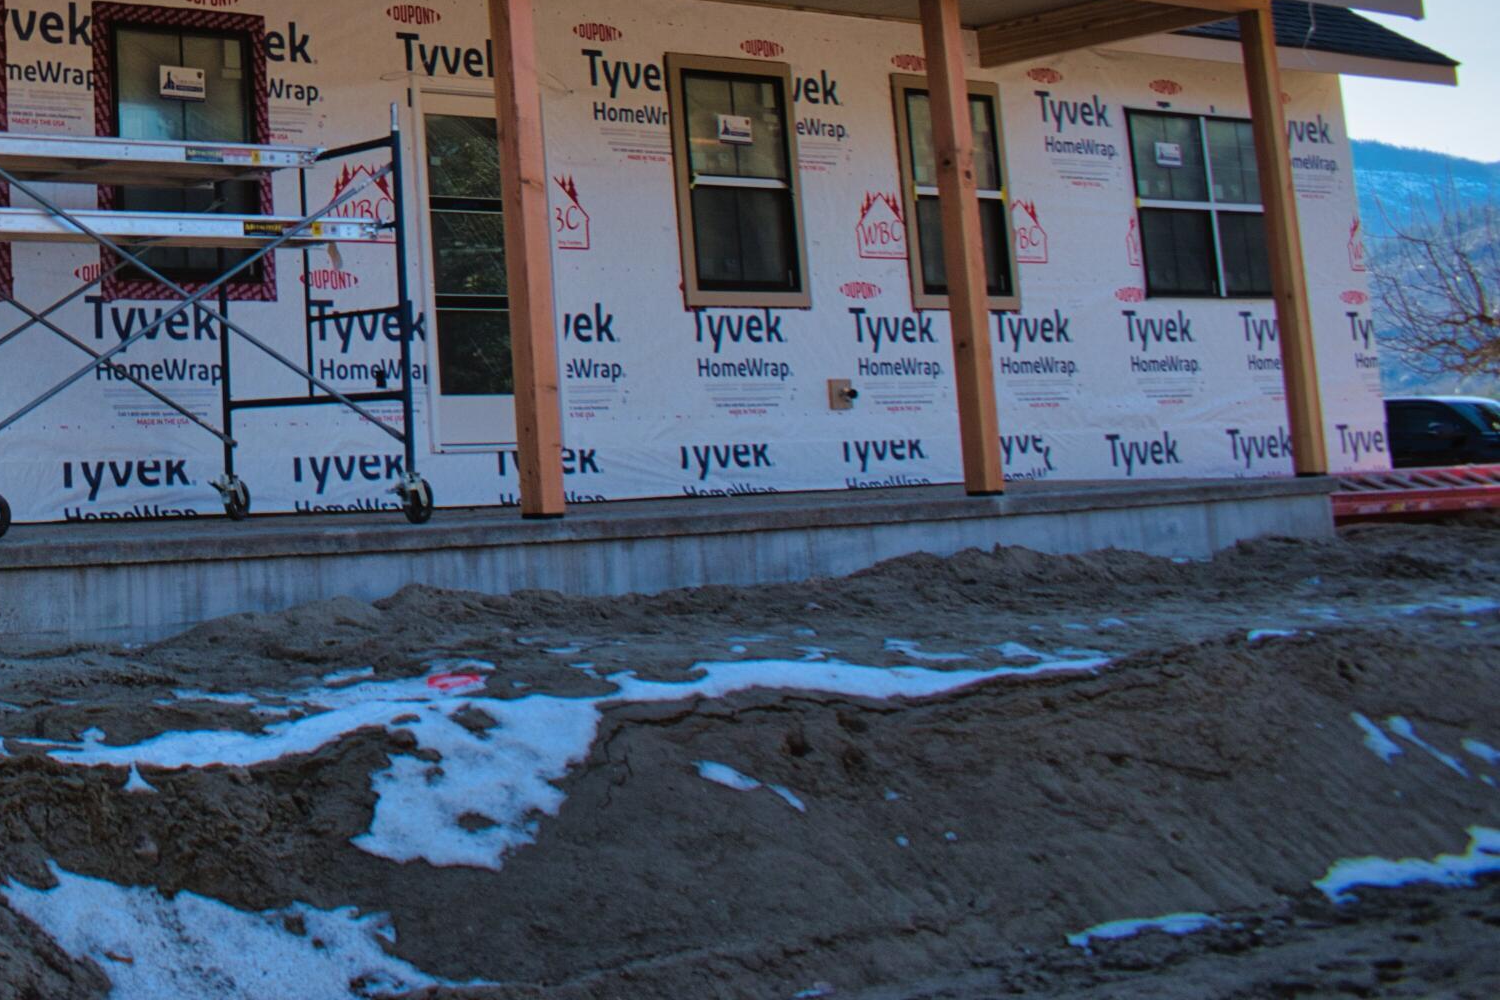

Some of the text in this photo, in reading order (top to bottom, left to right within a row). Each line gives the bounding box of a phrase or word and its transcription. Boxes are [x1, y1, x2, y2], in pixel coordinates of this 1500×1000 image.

[4, 2, 92, 46] vek
[393, 5, 435, 24] DUPONT
[579, 24, 617, 42] DUPONT
[745, 40, 779, 57] DUPONT
[1034, 90, 1109, 133] Tyvek
[1045, 136, 1115, 159] HomeWrap
[860, 220, 902, 246] WBC
[693, 308, 783, 353] Tyvek
[849, 307, 934, 353] Tyvek
[991, 309, 1069, 352] Tyvek
[1122, 310, 1193, 351] Tyvek
[697, 358, 789, 380] HomeWrap
[858, 358, 941, 379] HomeWrap
[1001, 357, 1076, 376] HomeWrap
[1130, 355, 1199, 374] HomeWrap
[1105, 431, 1180, 476] Tyvek
